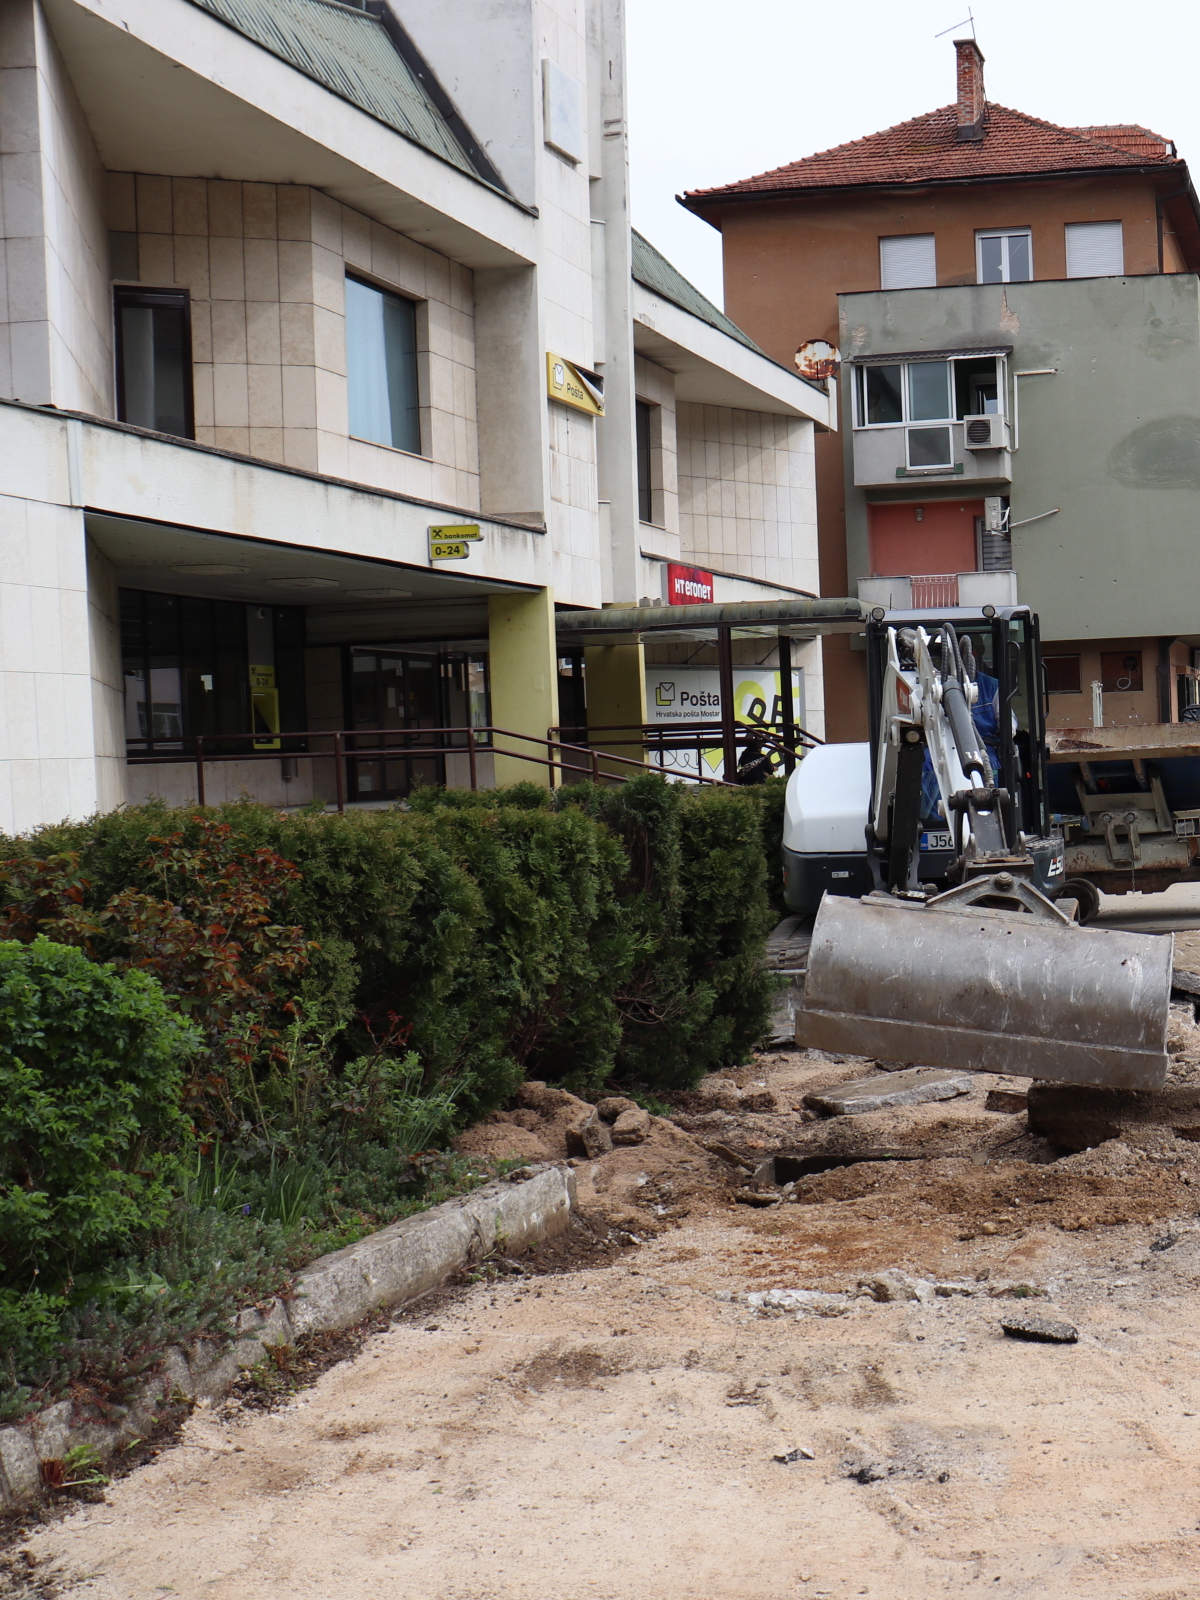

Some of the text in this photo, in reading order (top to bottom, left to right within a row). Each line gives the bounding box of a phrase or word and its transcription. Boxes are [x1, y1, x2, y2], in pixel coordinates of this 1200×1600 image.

[566, 382, 584, 400] Pošta
[435, 545, 461, 556] 0-24
[680, 690, 720, 706] Pošta
[656, 710, 682, 718] Hrvatska
[683, 710, 700, 719] pošta
